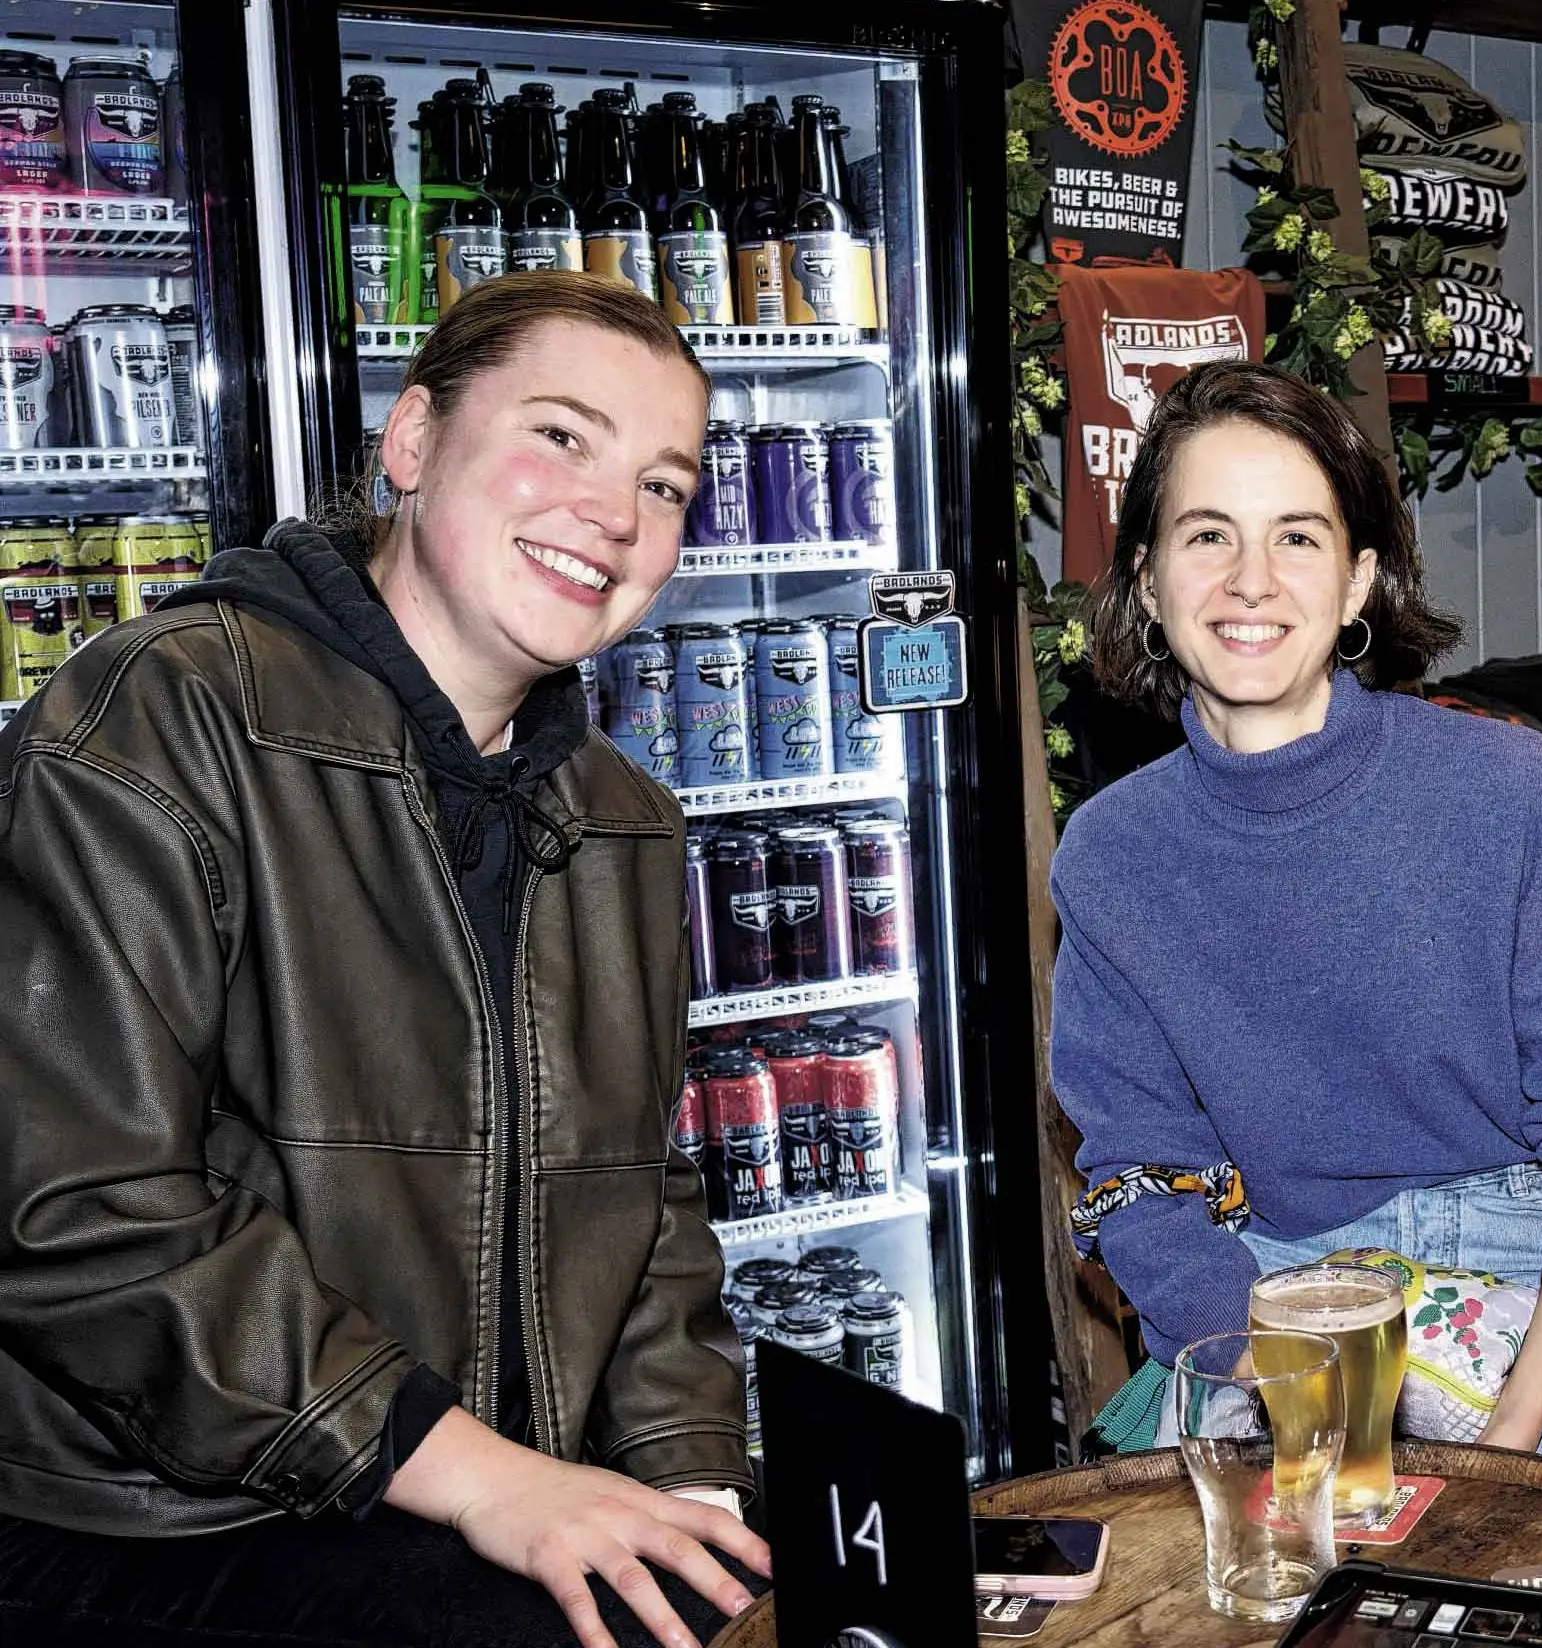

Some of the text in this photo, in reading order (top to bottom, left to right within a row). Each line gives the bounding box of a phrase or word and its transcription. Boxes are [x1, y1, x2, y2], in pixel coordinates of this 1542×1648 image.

[1100, 44, 1143, 101] BOA
[1055, 168, 1179, 197] BIKES, BEER &
[1050, 186, 1184, 219] THE PURSUIT OF
[1112, 321, 1231, 348] ADLANDS
[13, 588, 74, 599] BADLANDS
[883, 575, 943, 588] BADLANDS
[900, 643, 930, 663] NEW
[887, 665, 946, 689] RELEASE!
[791, 1142, 831, 1170] JAXO
[792, 1167, 816, 1181] red
[839, 1172, 860, 1187] red
[736, 1191, 761, 1206] red
[829, 1483, 888, 1586] 14
